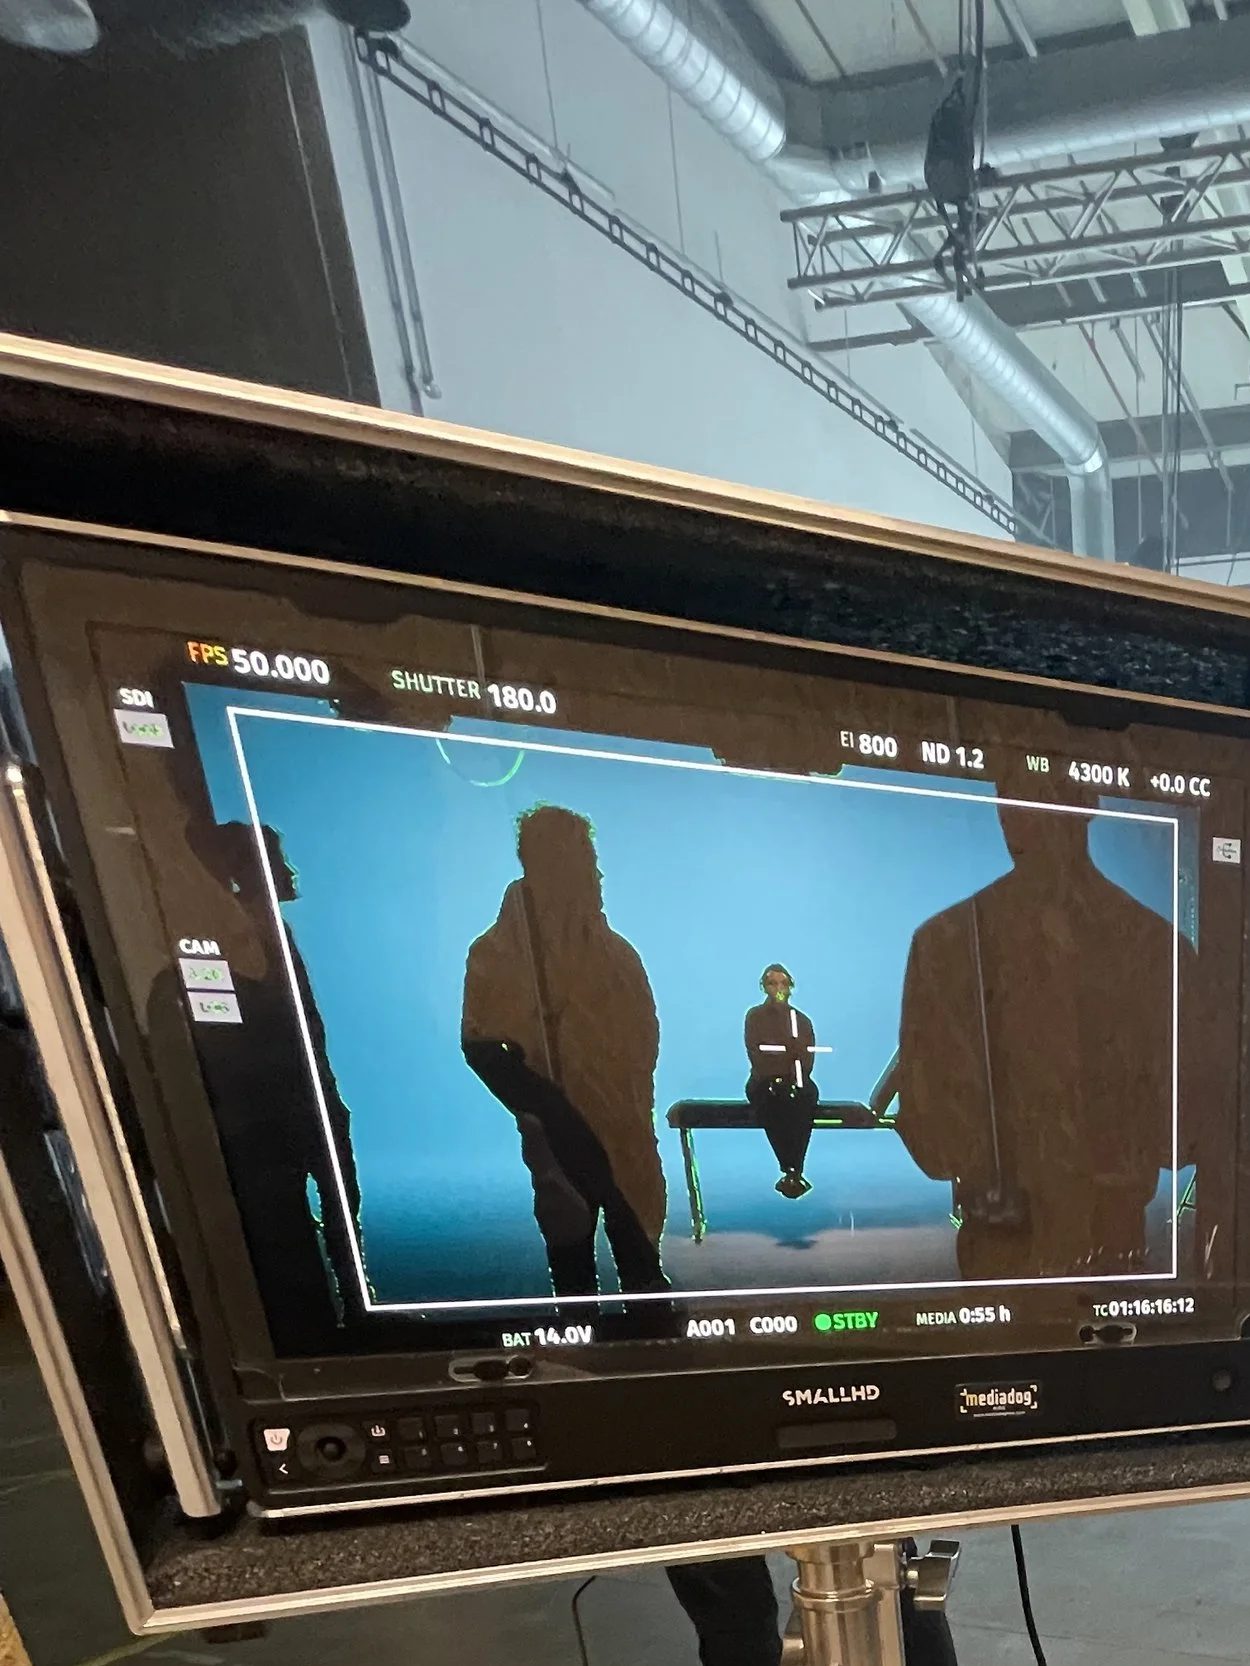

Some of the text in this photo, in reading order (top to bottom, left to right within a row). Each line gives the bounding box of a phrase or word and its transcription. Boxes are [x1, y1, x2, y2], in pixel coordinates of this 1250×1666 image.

[186, 641, 330, 685] FPS 50.000
[119, 687, 154, 709] SDI
[391, 669, 557, 715] SHUTTER 180.0
[840, 730, 898, 758] EI 800
[921, 740, 985, 770] ND 1.2
[1026, 755, 1131, 787] WB 4300 K
[1149, 771, 1211, 798] +0.0 CC
[179, 938, 221, 956] CAM
[915, 1305, 1011, 1326] MEDIA 0:55 h
[1093, 1297, 1195, 1318] TC 01:16:16:12
[686, 1318, 736, 1338] A001
[749, 1315, 799, 1335] C000
[833, 1311, 880, 1330] STBY
[502, 1325, 593, 1347] BAT 14.0V
[782, 1383, 881, 1406] SMALLHD
[965, 1387, 1032, 1407] mediadog
